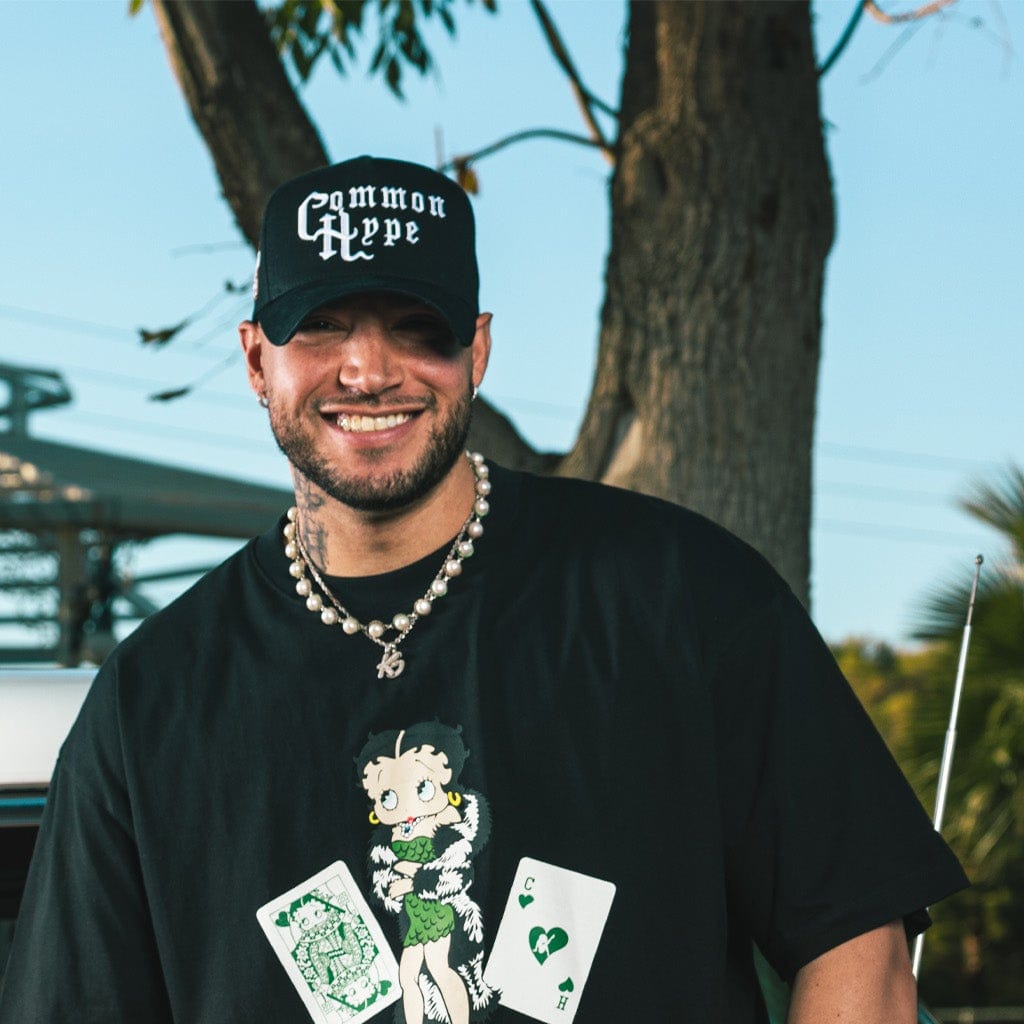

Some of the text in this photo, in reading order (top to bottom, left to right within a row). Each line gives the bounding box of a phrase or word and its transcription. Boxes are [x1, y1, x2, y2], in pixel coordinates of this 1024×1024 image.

[298, 185, 446, 241] Common
[318, 207, 419, 262] Hype
[524, 876, 535, 891] C
